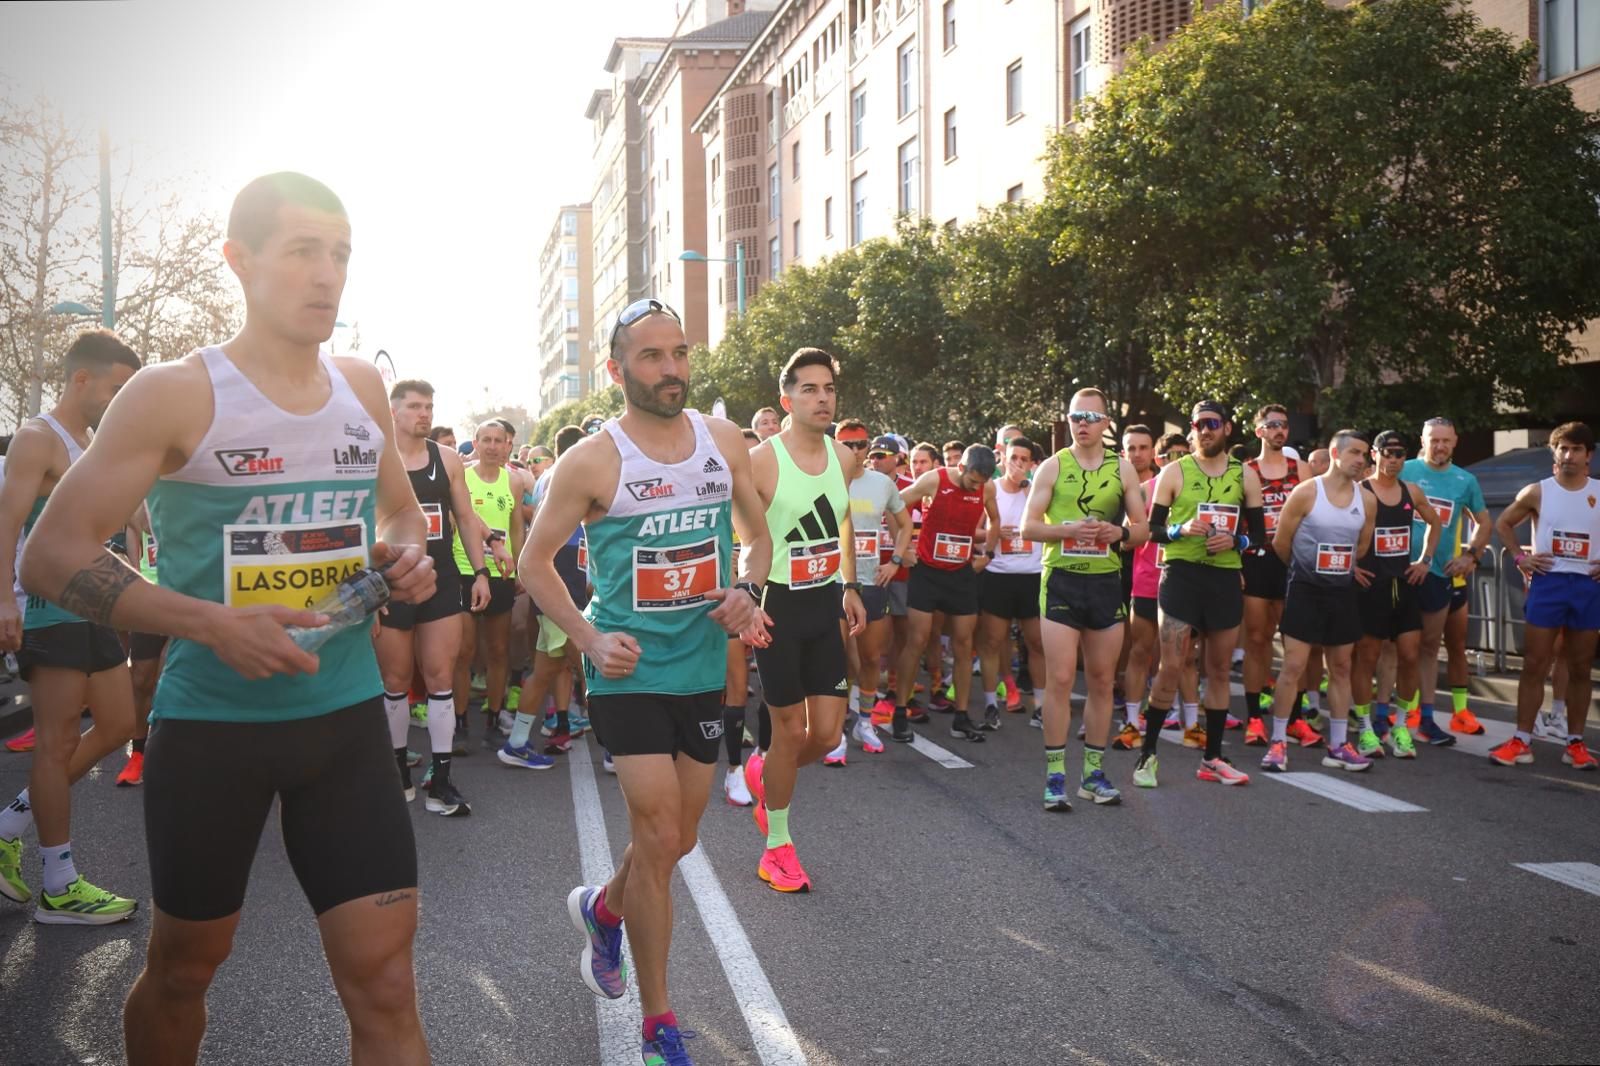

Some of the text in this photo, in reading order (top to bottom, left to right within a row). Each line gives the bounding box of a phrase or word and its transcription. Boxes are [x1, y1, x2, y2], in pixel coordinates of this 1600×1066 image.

[1262, 491, 1291, 503] ENY
[233, 489, 370, 524] ATLEET
[638, 507, 720, 536] ATLEET
[1385, 536, 1403, 547] 114
[1559, 540, 1583, 552] 109
[807, 558, 828, 574] 82
[663, 566, 697, 591] 37
[671, 589, 690, 598] JAVI
